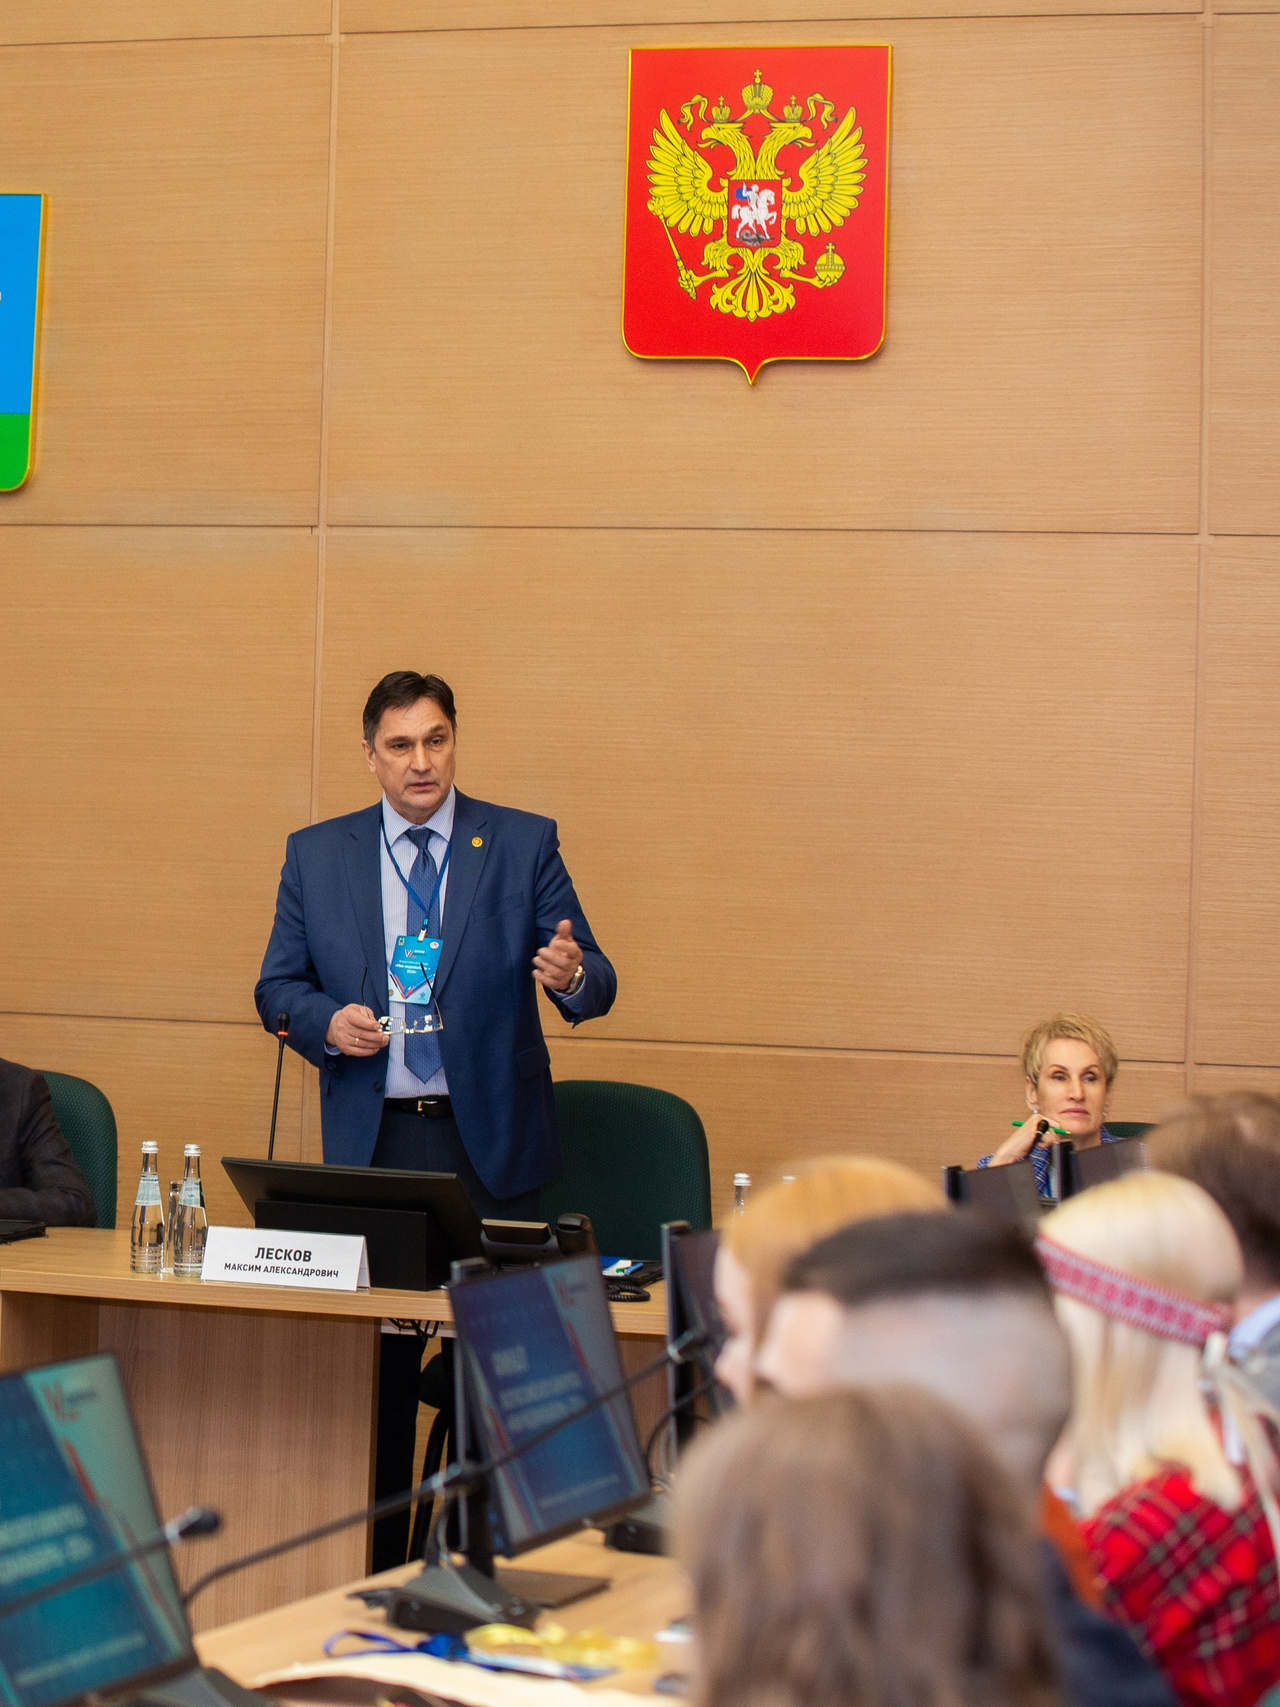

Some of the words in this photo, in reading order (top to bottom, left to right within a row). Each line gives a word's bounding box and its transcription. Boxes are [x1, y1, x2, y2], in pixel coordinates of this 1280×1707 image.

[255, 1247, 312, 1262] ЛЕСКОВ
[224, 1262, 261, 1272] МАКСИМ
[263, 1266, 339, 1277] АЛЕКСАНДРОВИЧ
